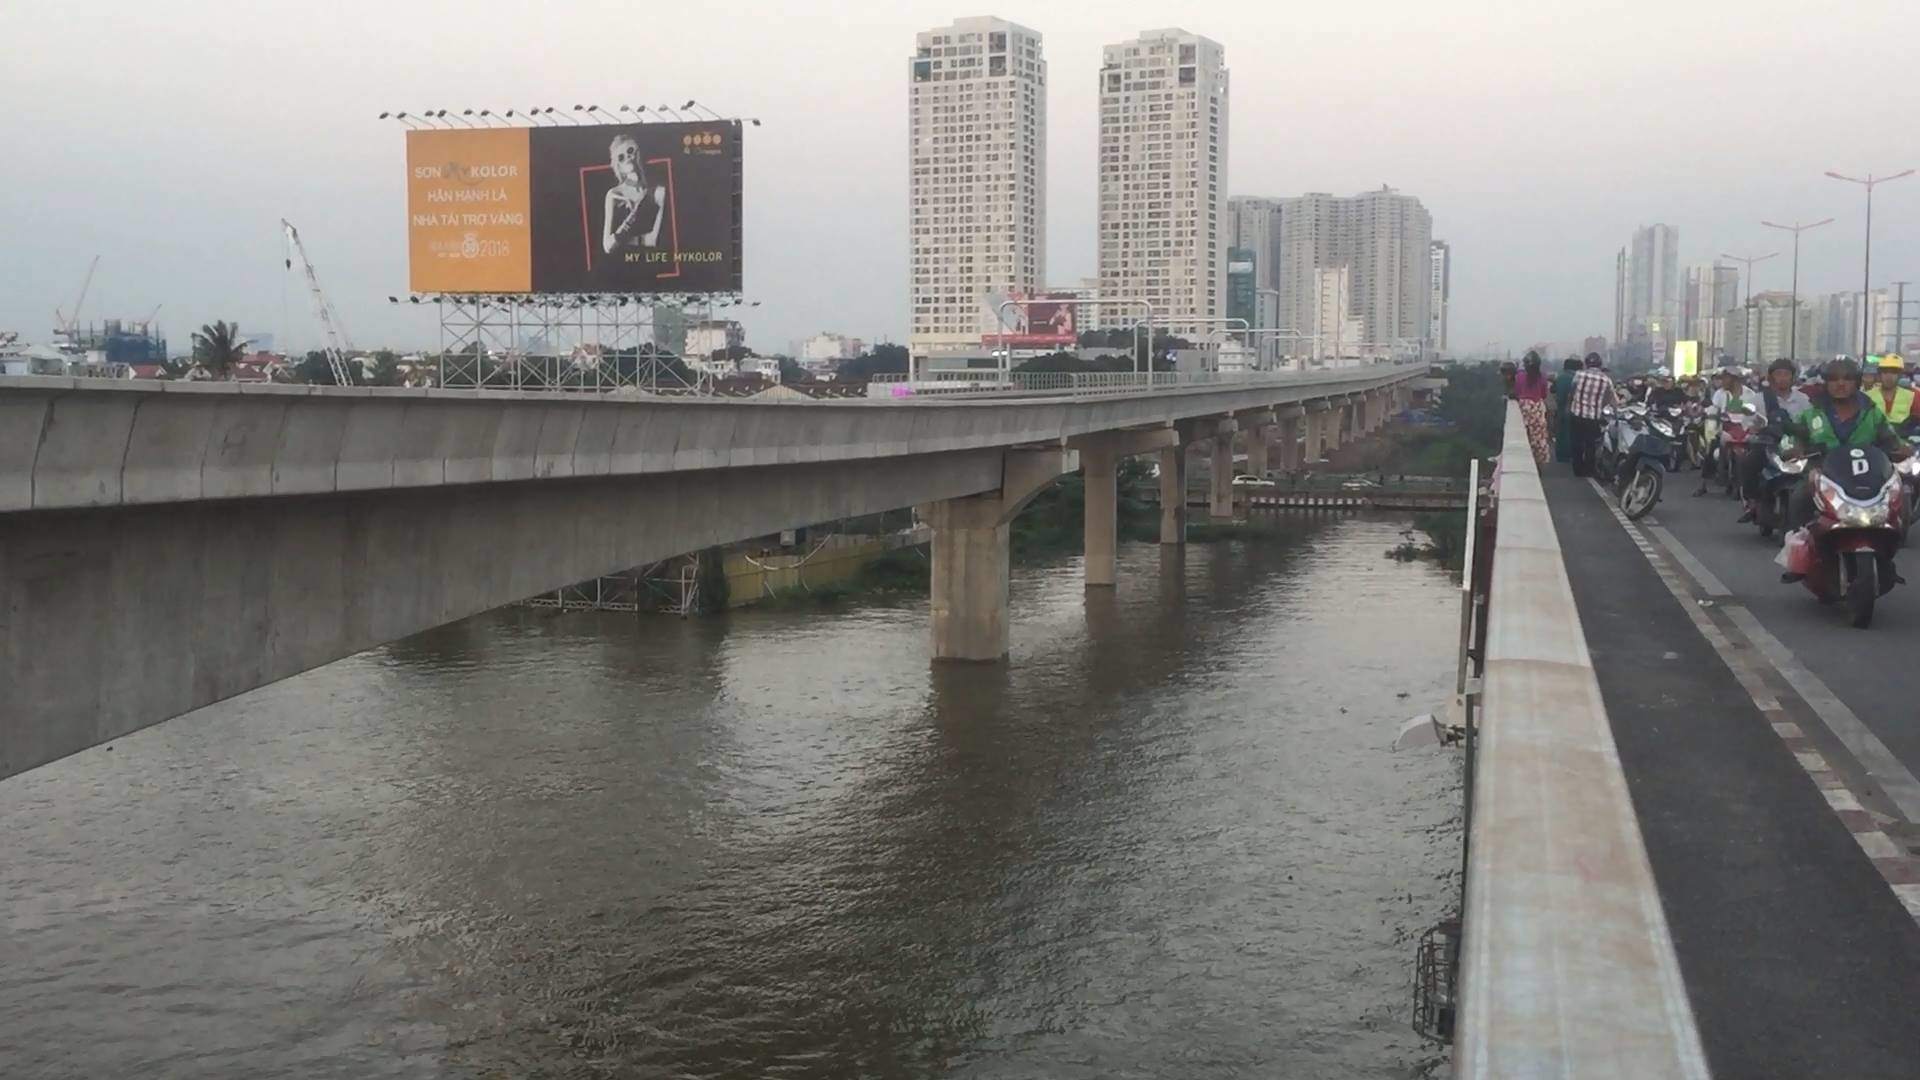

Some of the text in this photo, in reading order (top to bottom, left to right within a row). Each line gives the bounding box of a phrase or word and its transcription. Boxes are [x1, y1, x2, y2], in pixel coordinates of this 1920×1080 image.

[624, 251, 723, 263] MY LIFE MYKOLOR
[1852, 459, 1869, 476] D
